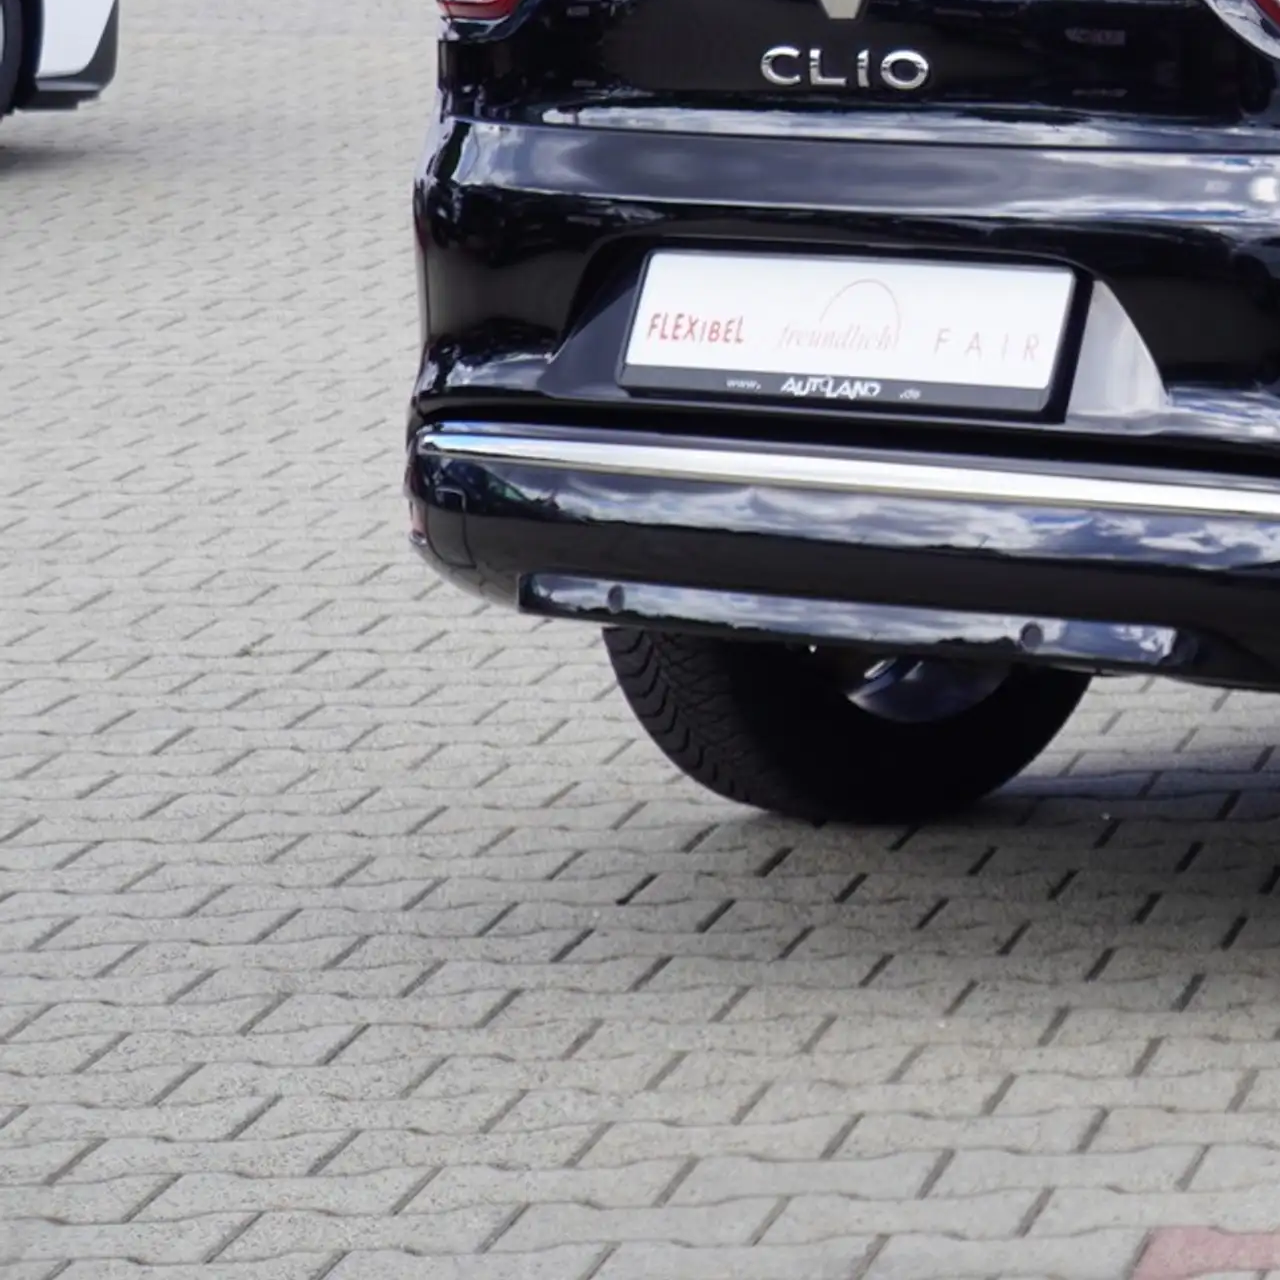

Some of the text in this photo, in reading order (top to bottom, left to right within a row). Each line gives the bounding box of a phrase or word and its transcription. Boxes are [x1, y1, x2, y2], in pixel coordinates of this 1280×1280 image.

[760, 45, 930, 90] CLIO
[646, 311, 744, 344] FLEXIBEL
[933, 326, 1040, 362] FAIR
[780, 374, 882, 399] AUTOLAND
